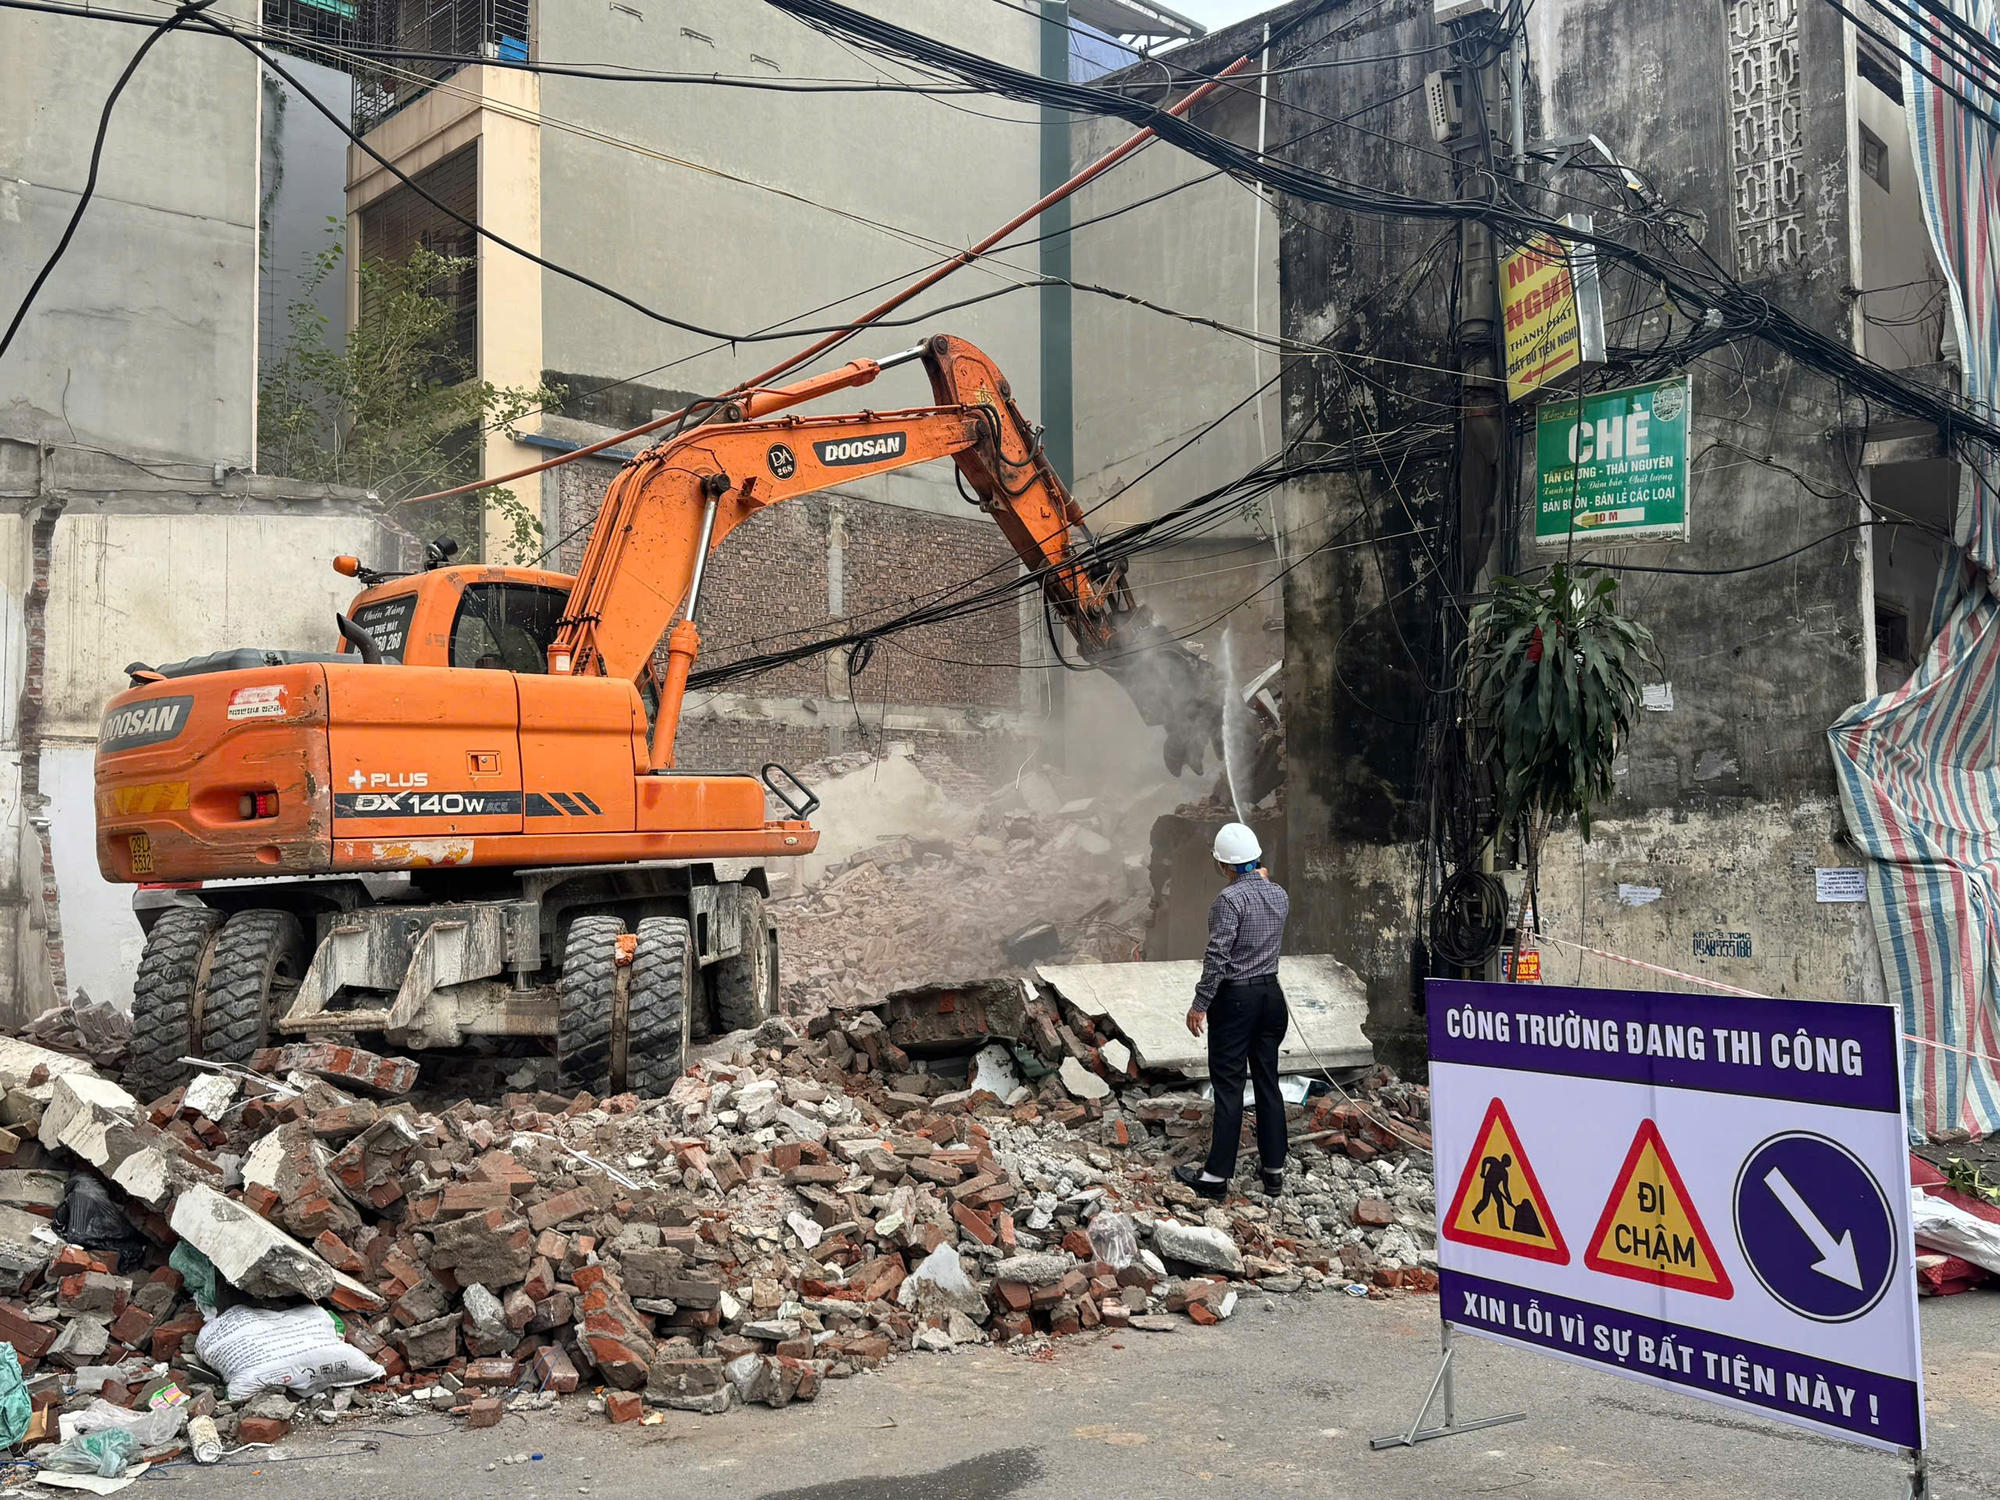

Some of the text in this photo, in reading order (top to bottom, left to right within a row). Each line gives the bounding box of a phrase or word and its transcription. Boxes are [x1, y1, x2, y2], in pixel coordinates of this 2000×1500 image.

[1510, 325, 1544, 352] THÀNH
[1568, 402, 1650, 464] CHÈ
[825, 437, 900, 462] DOOSAN
[777, 465, 793, 476] 268
[1606, 461, 1628, 476] THÁI
[1631, 456, 1674, 472] NGUYÊN
[1542, 500, 1561, 513] BÁN
[1595, 493, 1614, 507] BÁN
[1616, 487, 1627, 503] LẺ
[1630, 488, 1650, 503] CÁC
[1652, 486, 1675, 503] LOẠI
[1608, 511, 1618, 521] M
[387, 631, 402, 651] 268
[102, 704, 181, 744] DOOSAN
[371, 772, 428, 788] PLUS
[1446, 1003, 1863, 1077] CÔNG TRƯỜNG ĐANG THI CÔNG
[1637, 1181, 1665, 1216] ĐI
[1614, 1223, 1696, 1270] CHẬM
[1463, 1290, 1880, 1426] XIN LỖI VÌ SỰ BẤT TIỆN NÀY !
